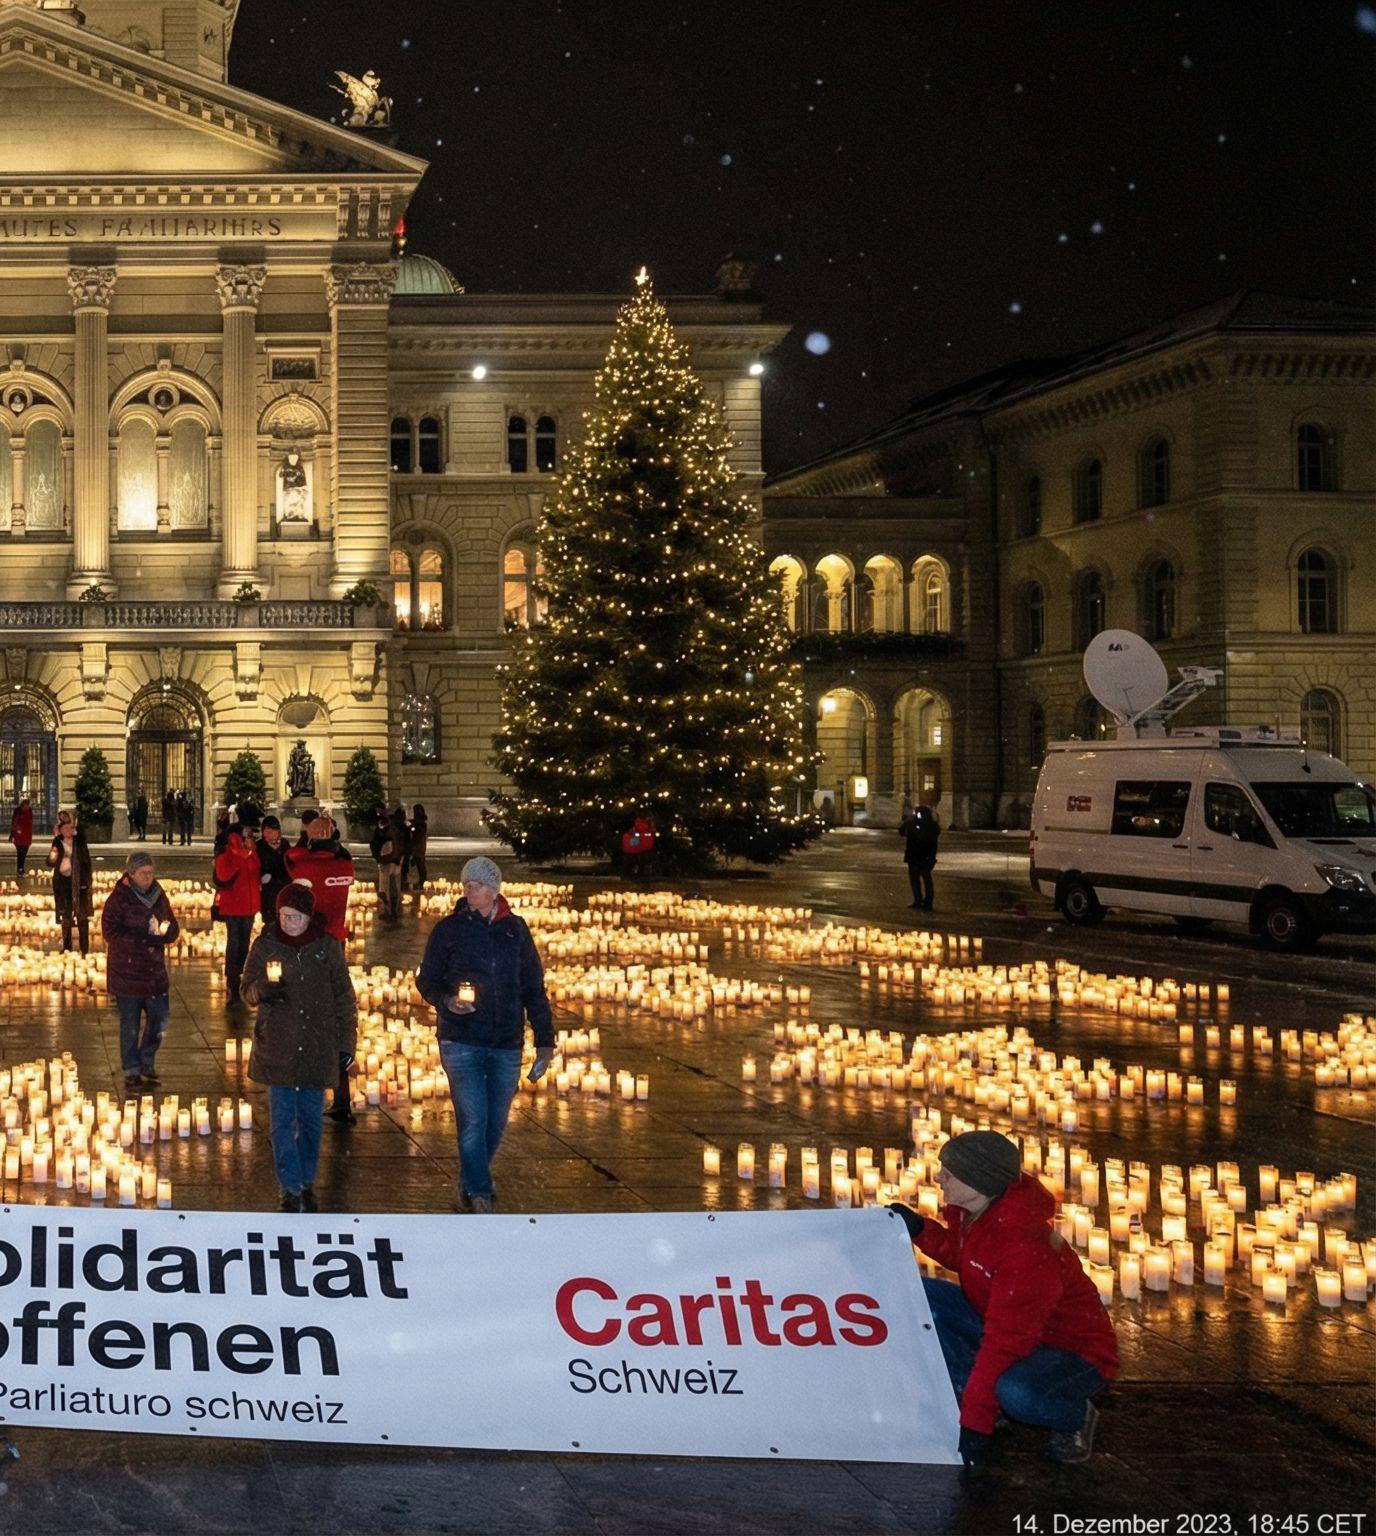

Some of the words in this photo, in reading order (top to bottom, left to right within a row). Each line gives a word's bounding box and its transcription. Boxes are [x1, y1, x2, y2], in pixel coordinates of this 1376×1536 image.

[555, 1276, 888, 1347] Caritas
[569, 1359, 744, 1394] Schweiz
[186, 1390, 348, 1424] schweiz
